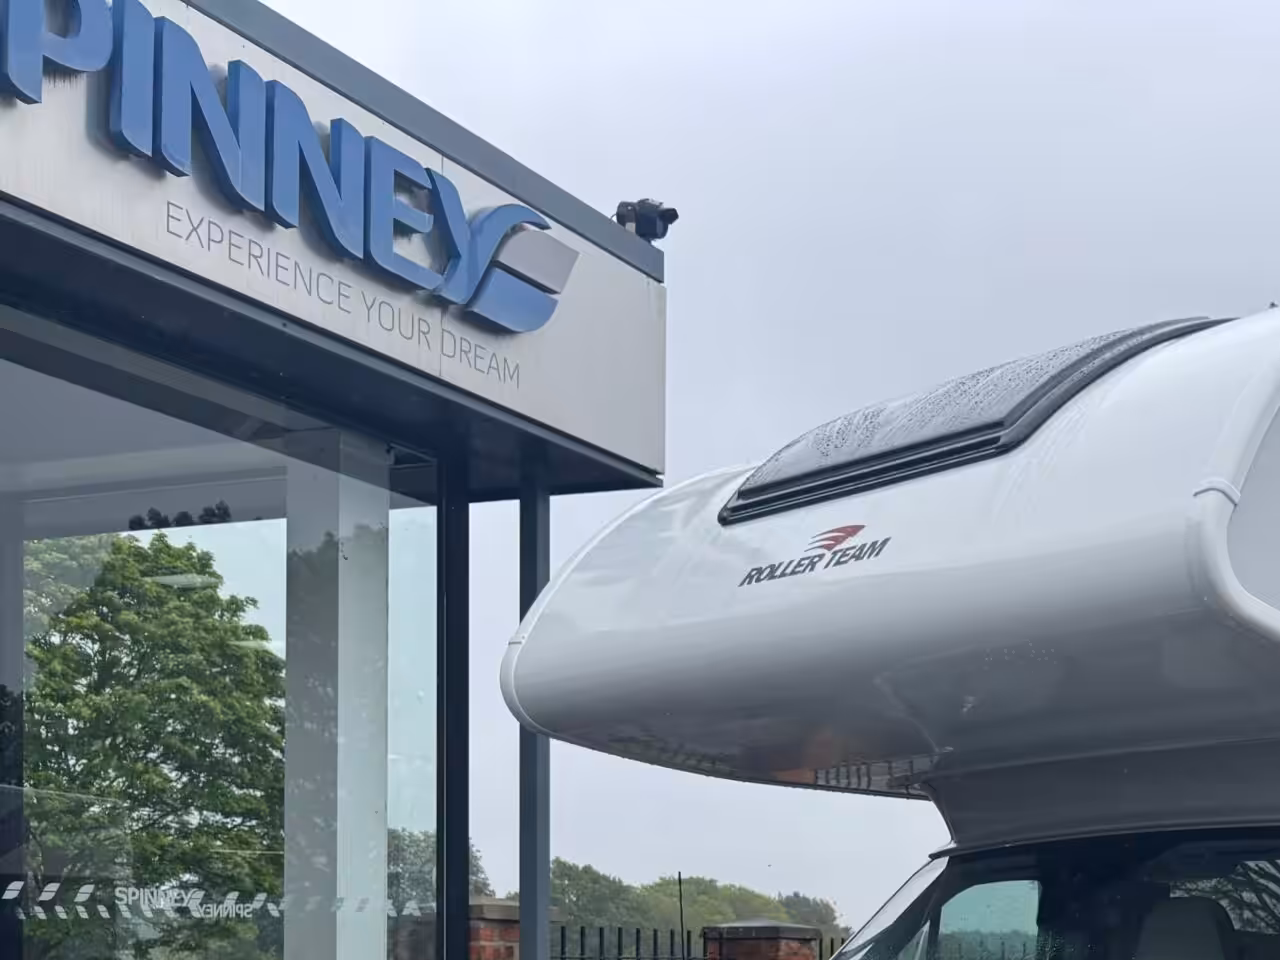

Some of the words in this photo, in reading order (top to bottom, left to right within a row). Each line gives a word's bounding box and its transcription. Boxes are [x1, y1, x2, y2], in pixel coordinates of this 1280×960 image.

[166, 199, 353, 315] EXPERIENCE
[360, 290, 432, 351] YOUR
[440, 327, 521, 390] DREAM
[737, 553, 826, 588] ROLLER
[823, 536, 892, 570] TEAM
[114, 886, 195, 907] SPINNEY
